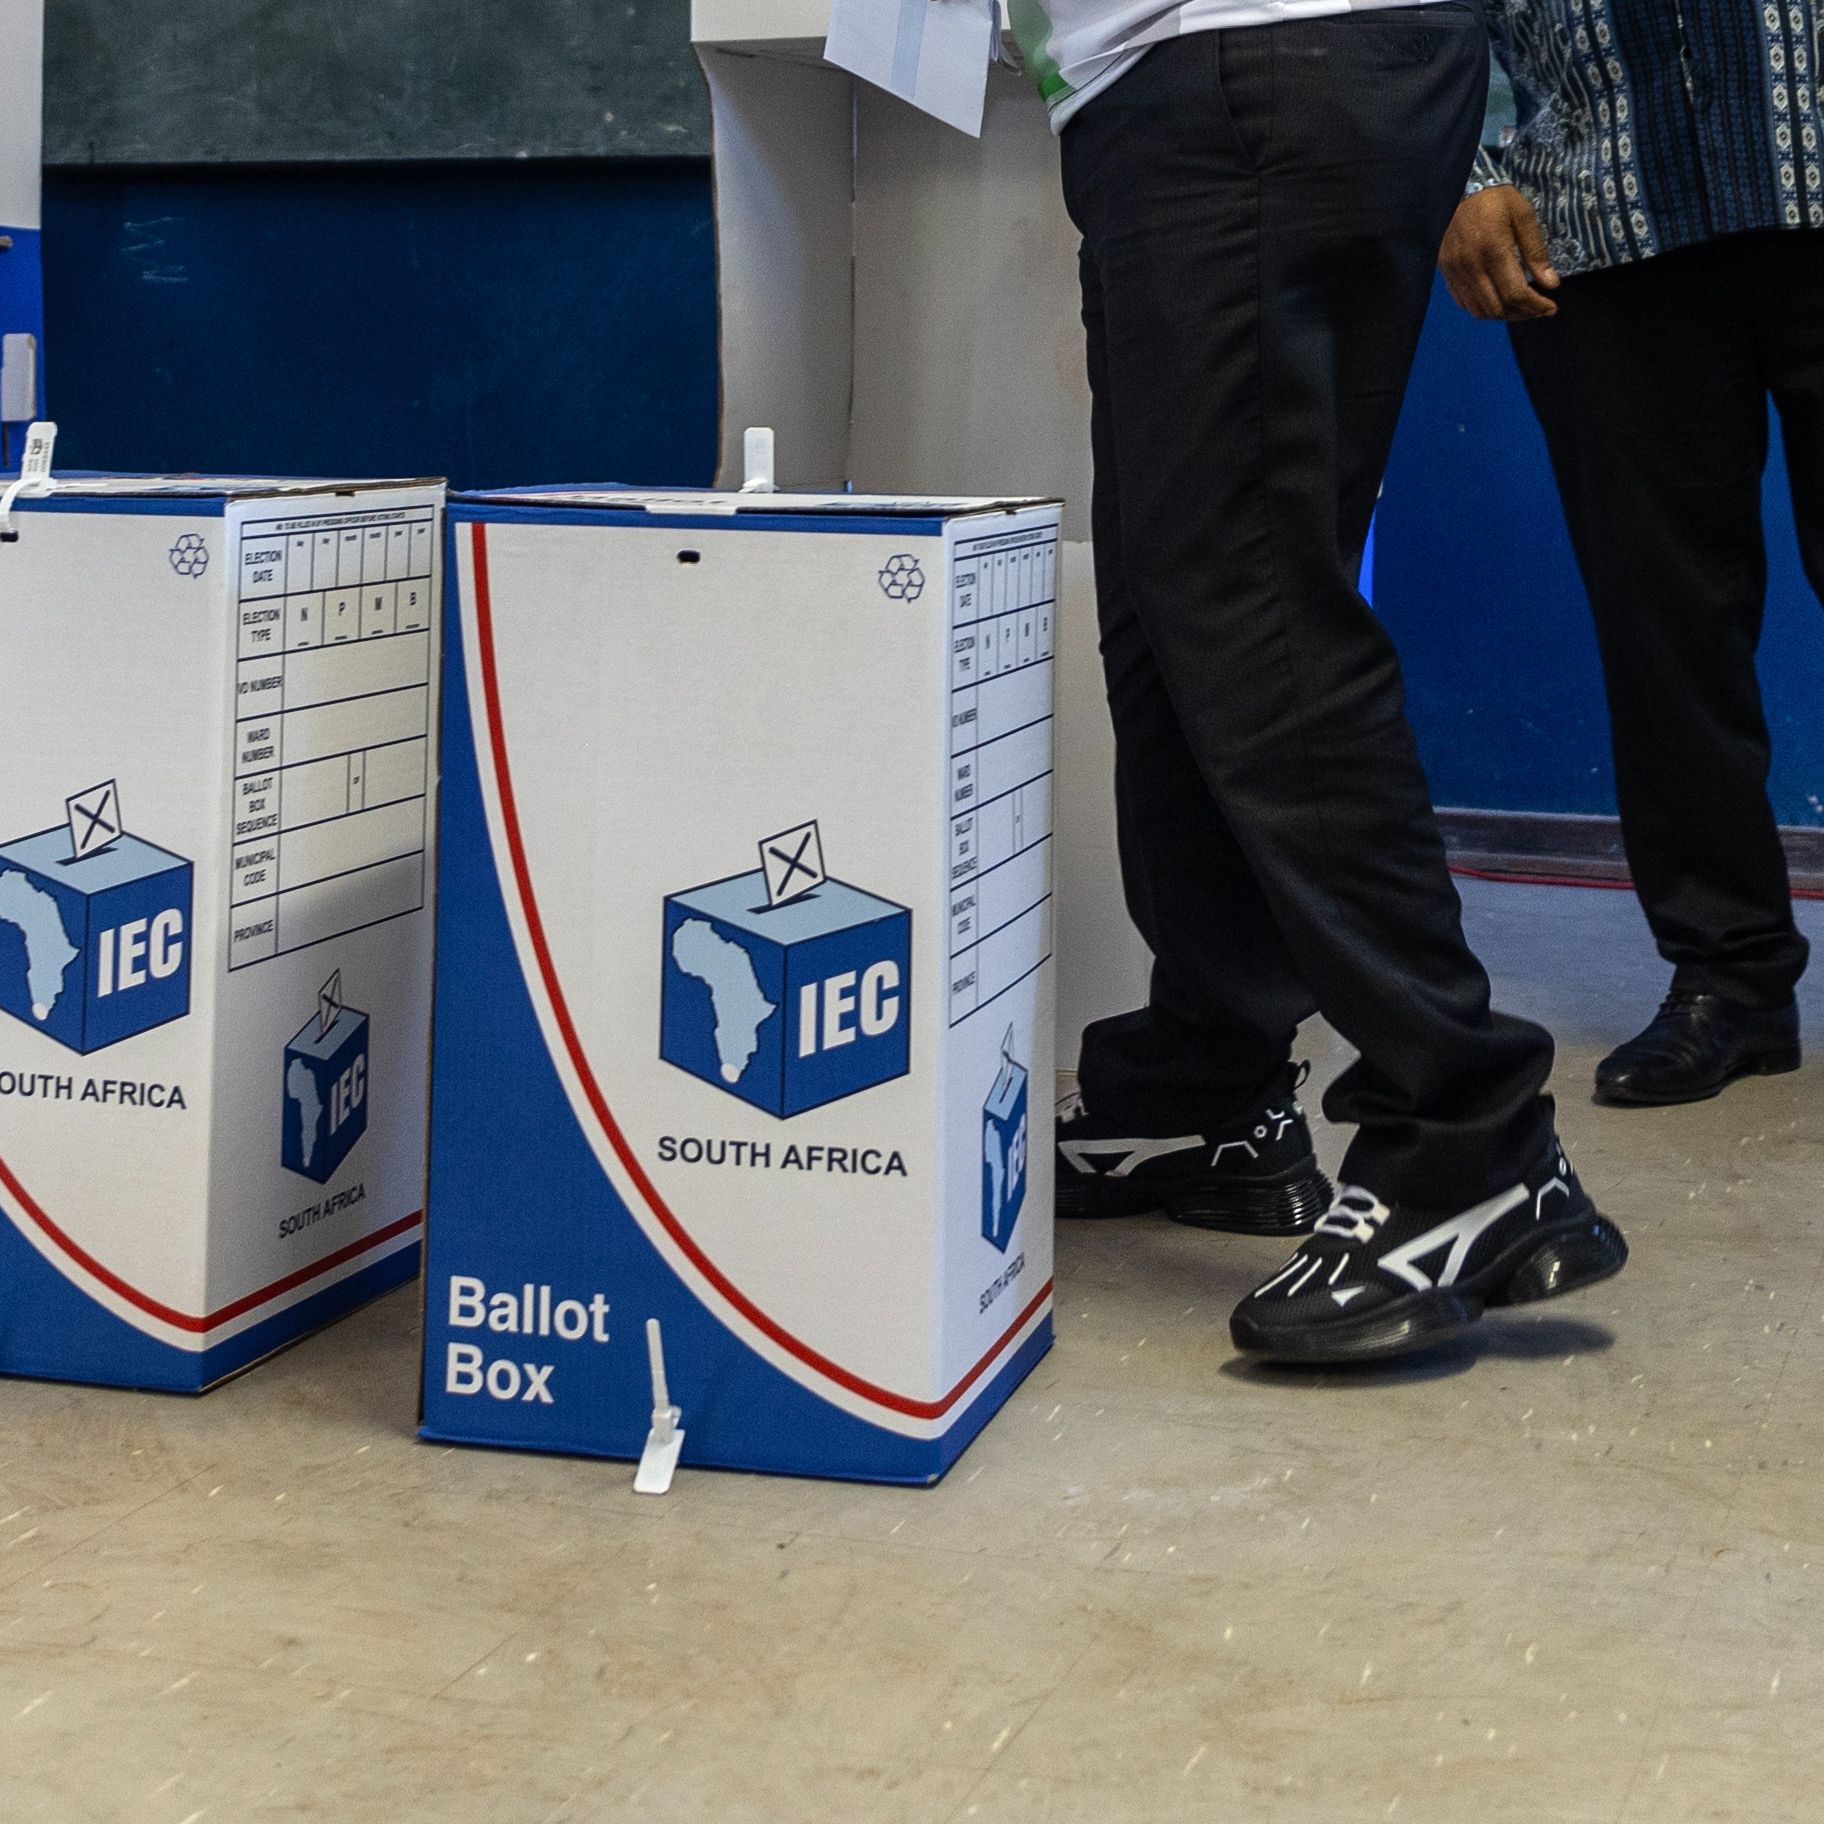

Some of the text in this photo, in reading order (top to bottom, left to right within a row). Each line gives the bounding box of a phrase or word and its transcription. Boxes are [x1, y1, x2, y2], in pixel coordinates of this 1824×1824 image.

[245, 550, 282, 565] ELECTION
[243, 608, 280, 625] ELECTION
[97, 908, 184, 998] IEC
[798, 958, 901, 1059] IEC
[80, 1079, 187, 1110] AFRICA
[330, 1052, 366, 1136] IEC
[657, 1136, 908, 1177] SOUTH AFRICA
[279, 1183, 366, 1239] SOUTH AFRICA
[448, 1274, 611, 1343] Ballot
[446, 1341, 555, 1404] Box
